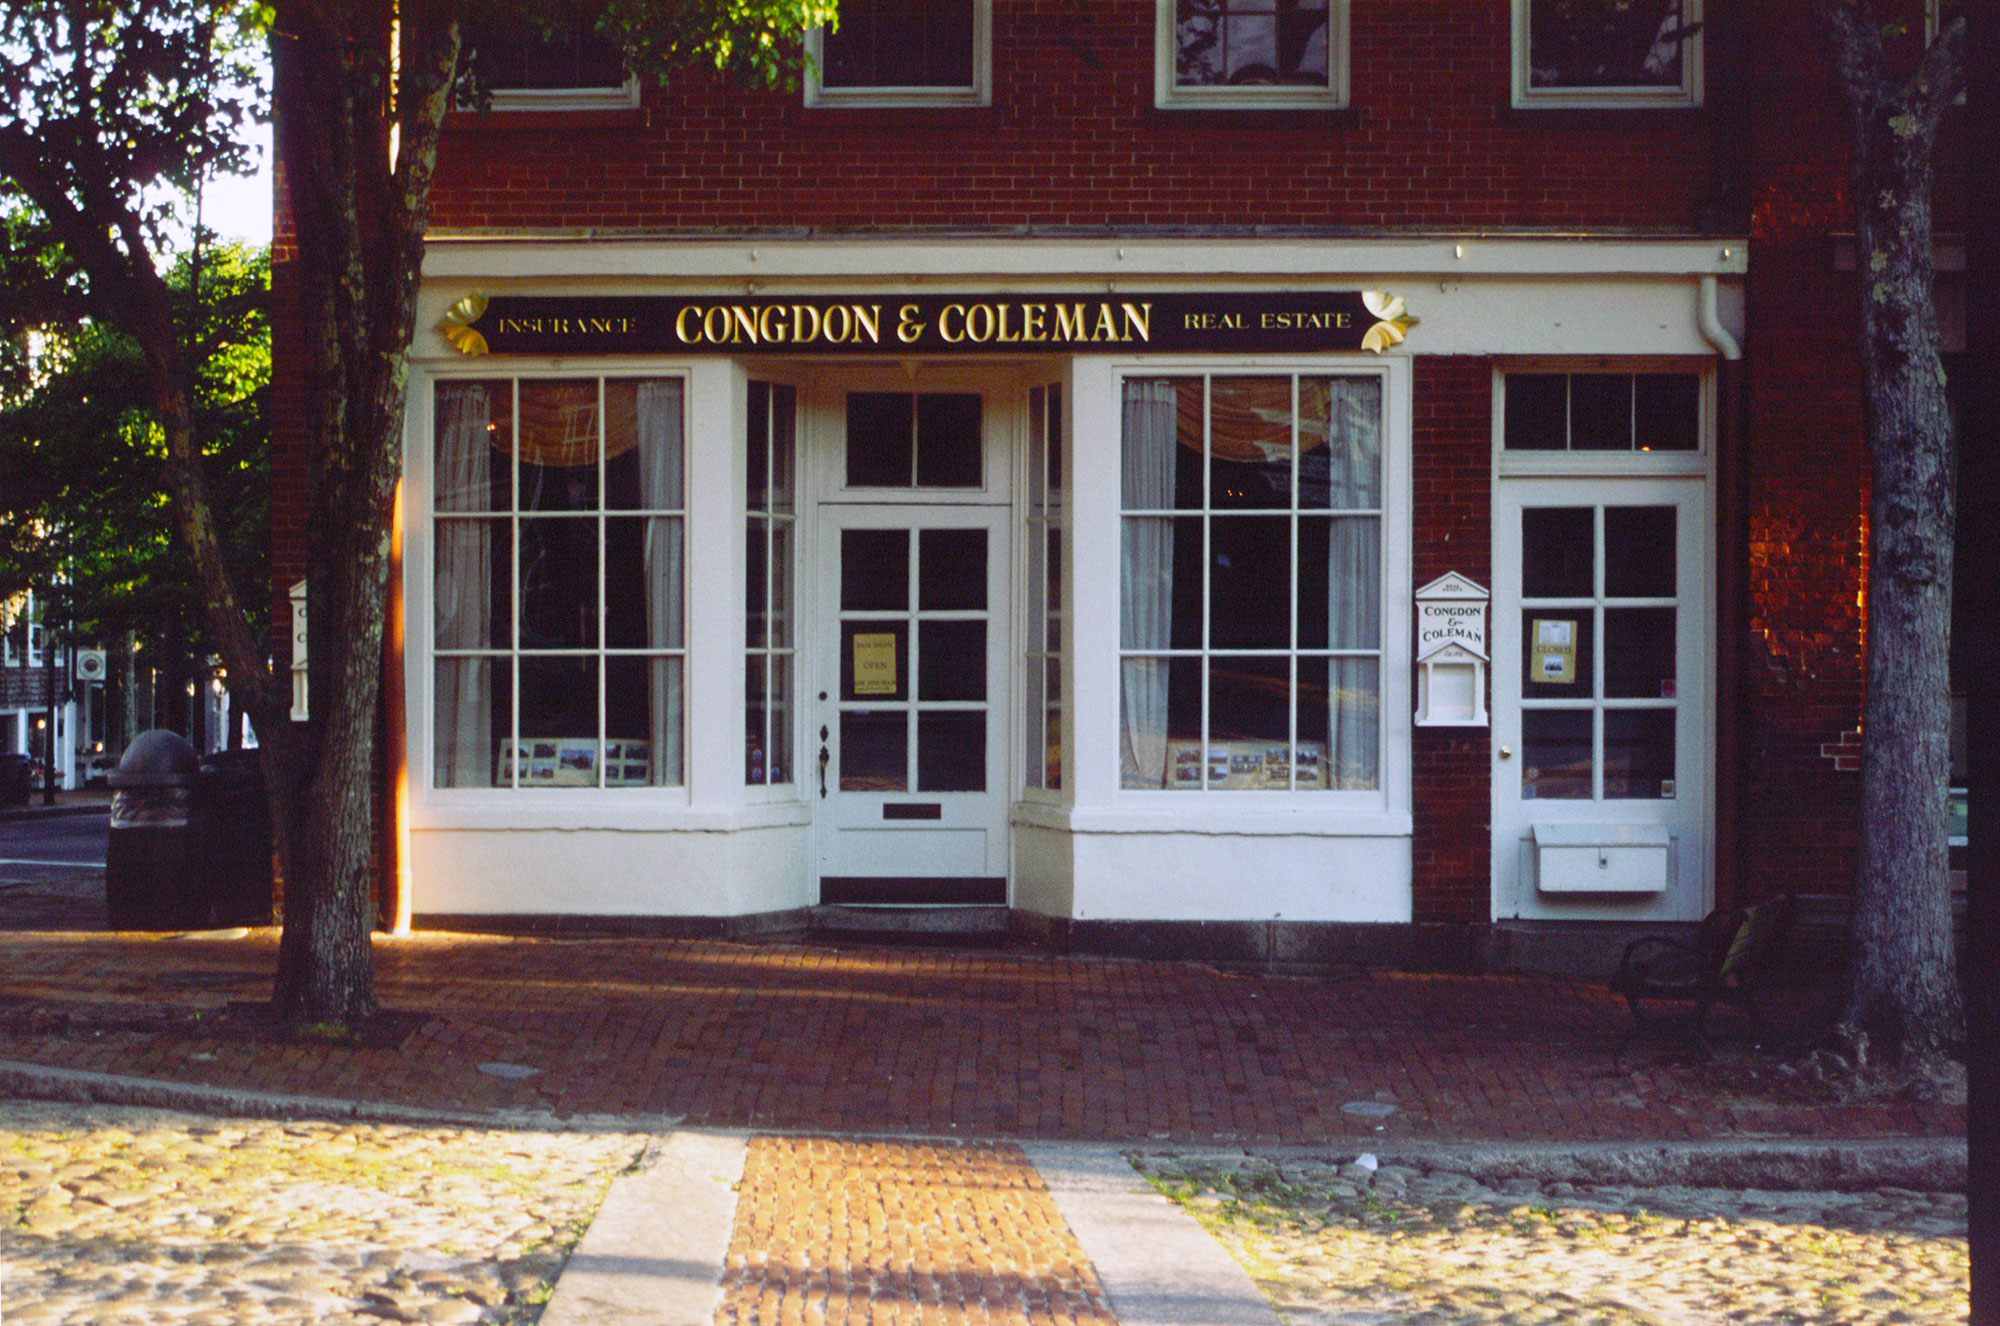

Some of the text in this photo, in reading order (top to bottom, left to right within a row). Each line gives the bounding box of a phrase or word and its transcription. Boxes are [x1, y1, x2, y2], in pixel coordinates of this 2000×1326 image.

[499, 318, 637, 334] INSURANCE
[675, 303, 1152, 344] CONGDON & COLEMAN
[1183, 312, 1351, 329] REAL ESTATE
[1424, 606, 1481, 617] CONGDON
[1447, 617, 1464, 627] &
[1422, 628, 1482, 643] COLEMAN
[1536, 645, 1572, 655] CLOSED
[863, 661, 887, 670] OPEN
